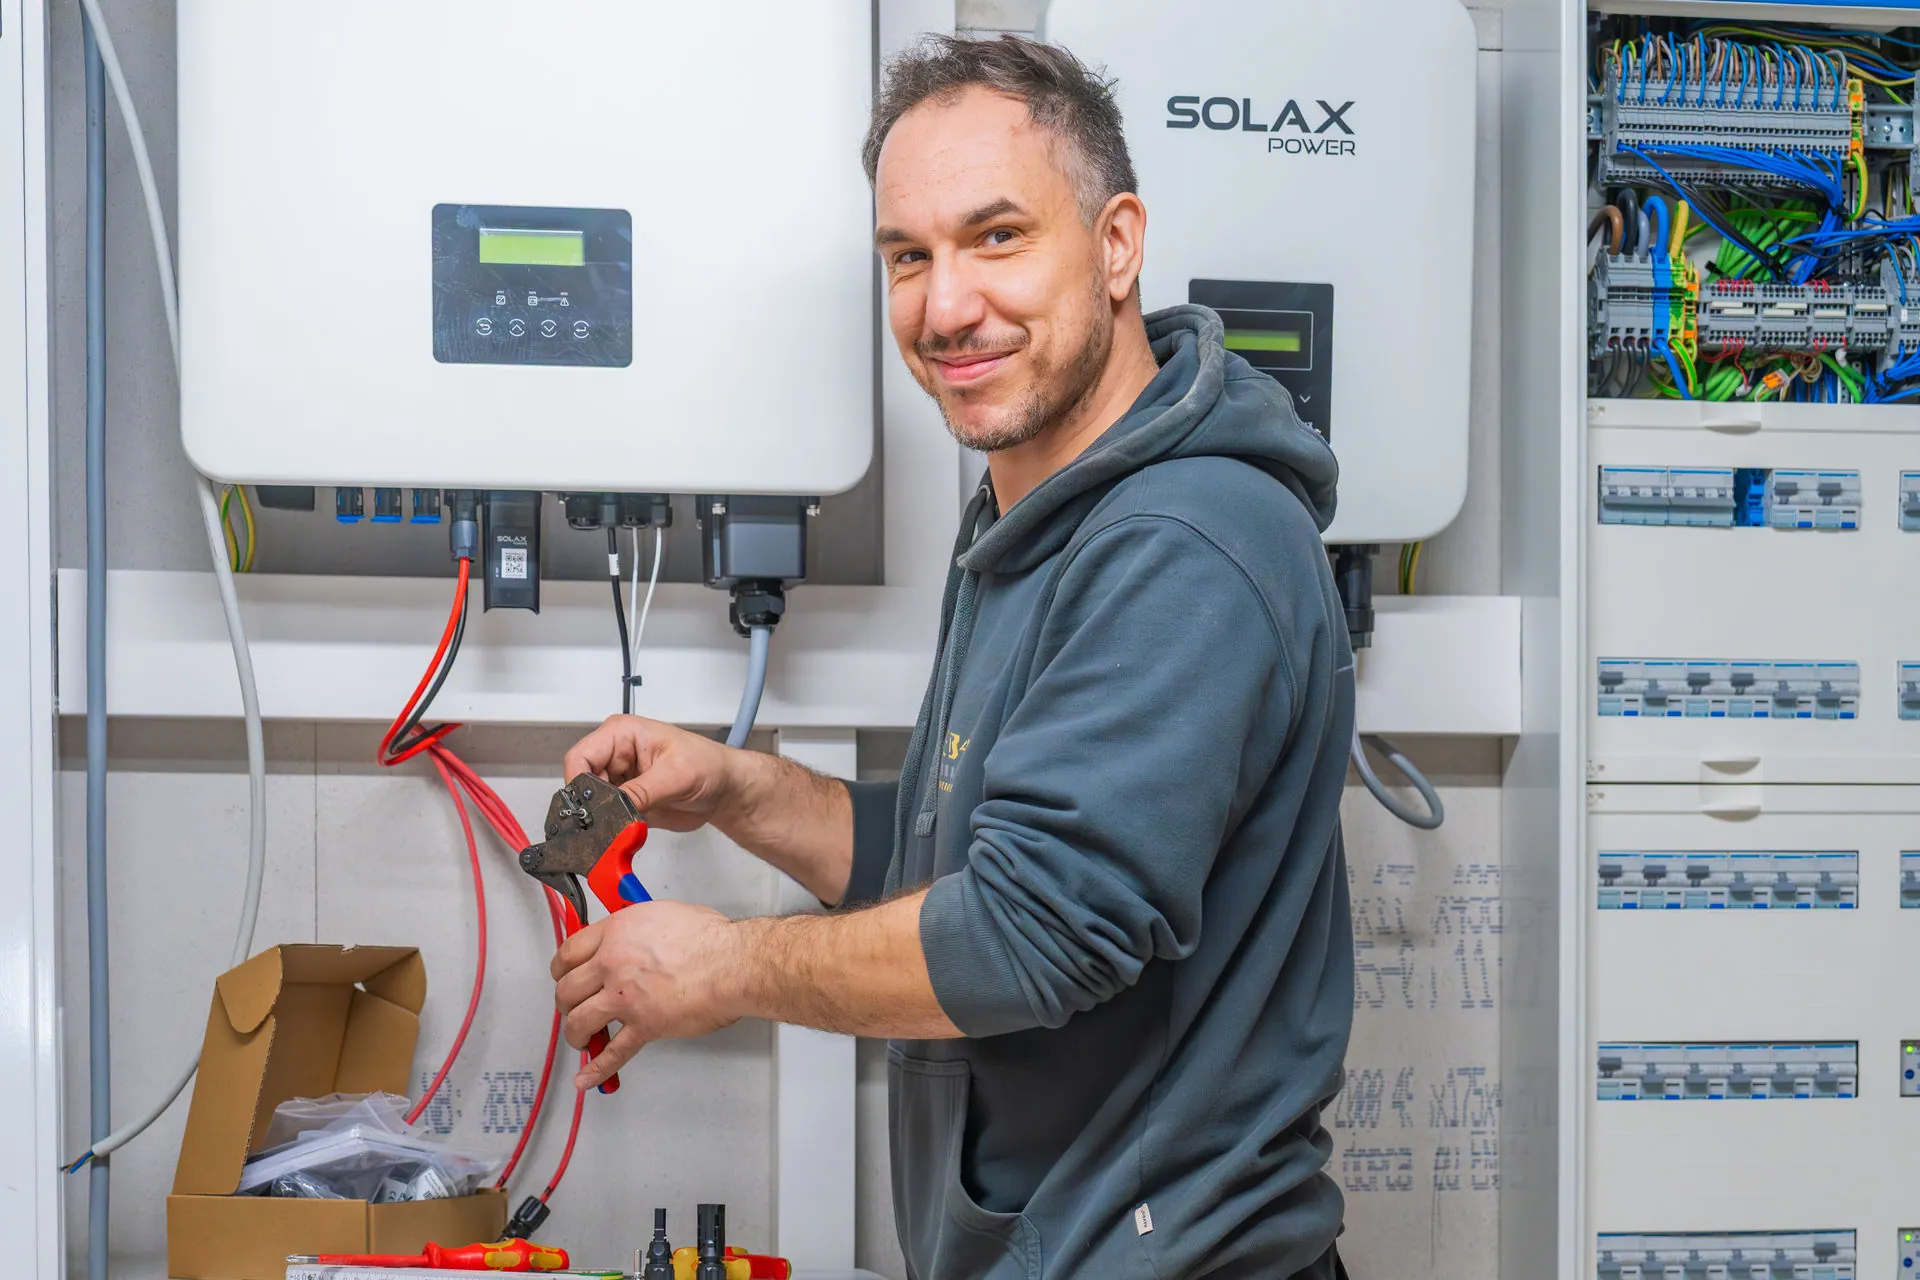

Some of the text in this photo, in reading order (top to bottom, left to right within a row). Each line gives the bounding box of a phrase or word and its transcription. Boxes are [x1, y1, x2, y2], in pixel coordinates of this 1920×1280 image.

[1166, 95, 1356, 135] SOLAX
[1268, 138, 1356, 156] POWER
[496, 535, 528, 543] SOLAX
